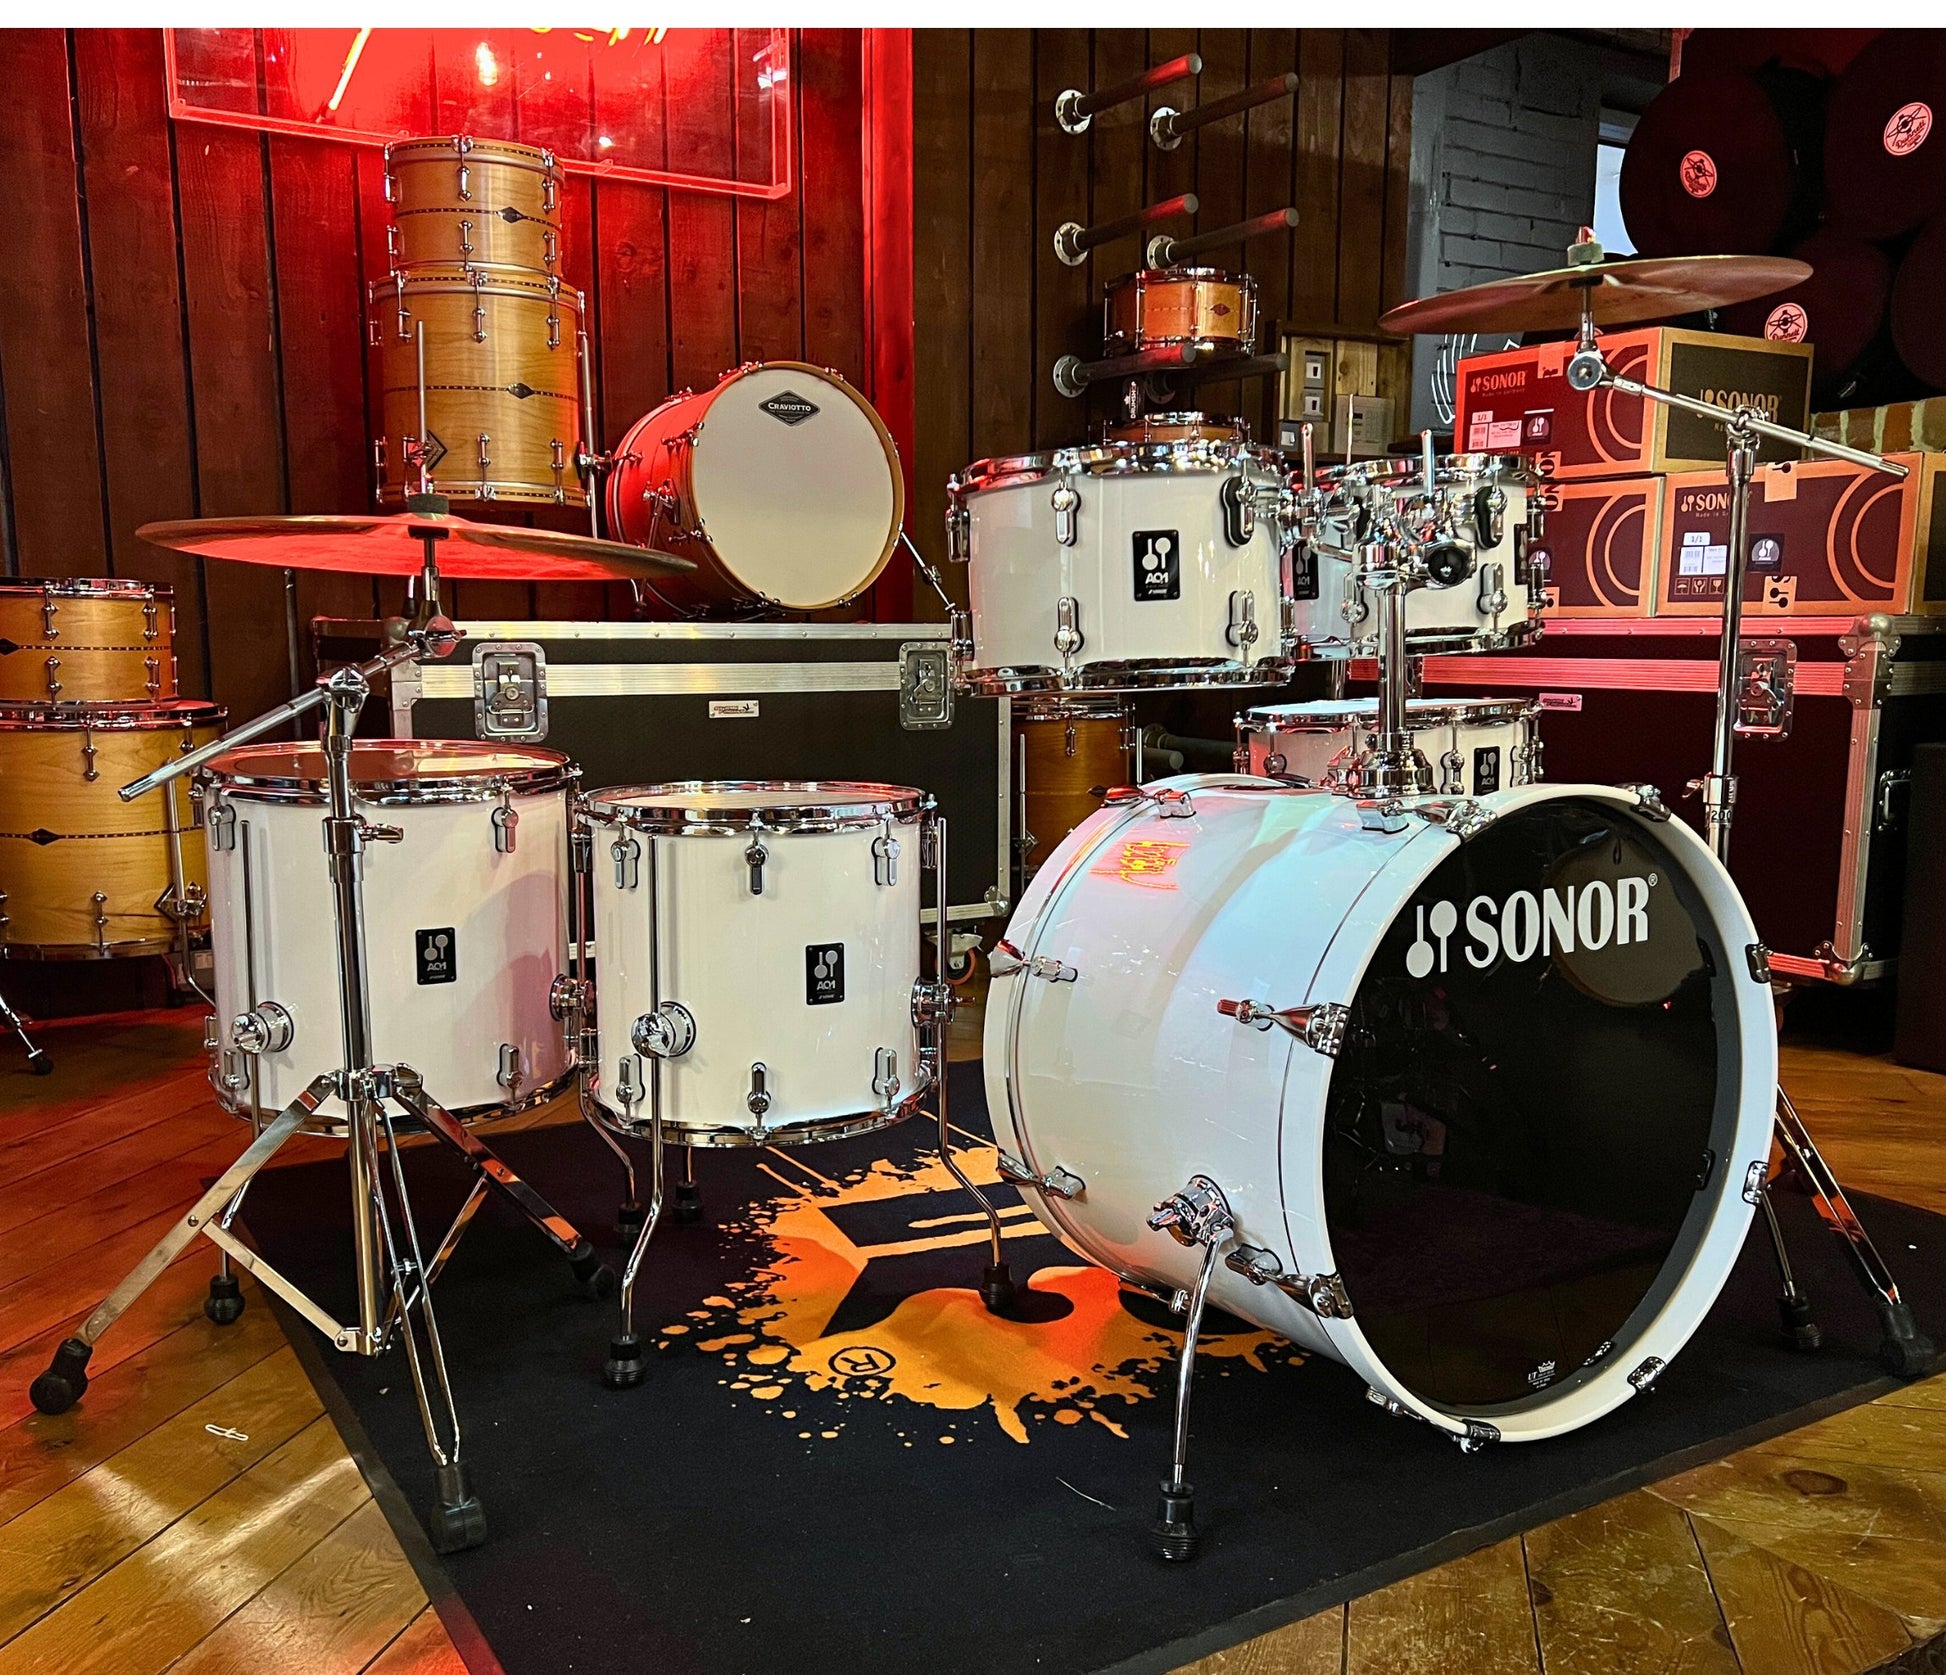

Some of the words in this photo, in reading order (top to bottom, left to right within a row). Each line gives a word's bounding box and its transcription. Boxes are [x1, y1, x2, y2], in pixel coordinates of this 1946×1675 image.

[1483, 370, 1527, 391] SONOR
[1129, 381, 1137, 419] DRUMSHOP
[767, 402, 812, 411] CRAVIOTTO
[1695, 493, 1730, 511] SON
[1691, 535, 1703, 543] 1/1
[1145, 571, 1169, 585] AQ1
[426, 961, 447, 971] AQ1
[816, 979, 836, 990] AQ1
